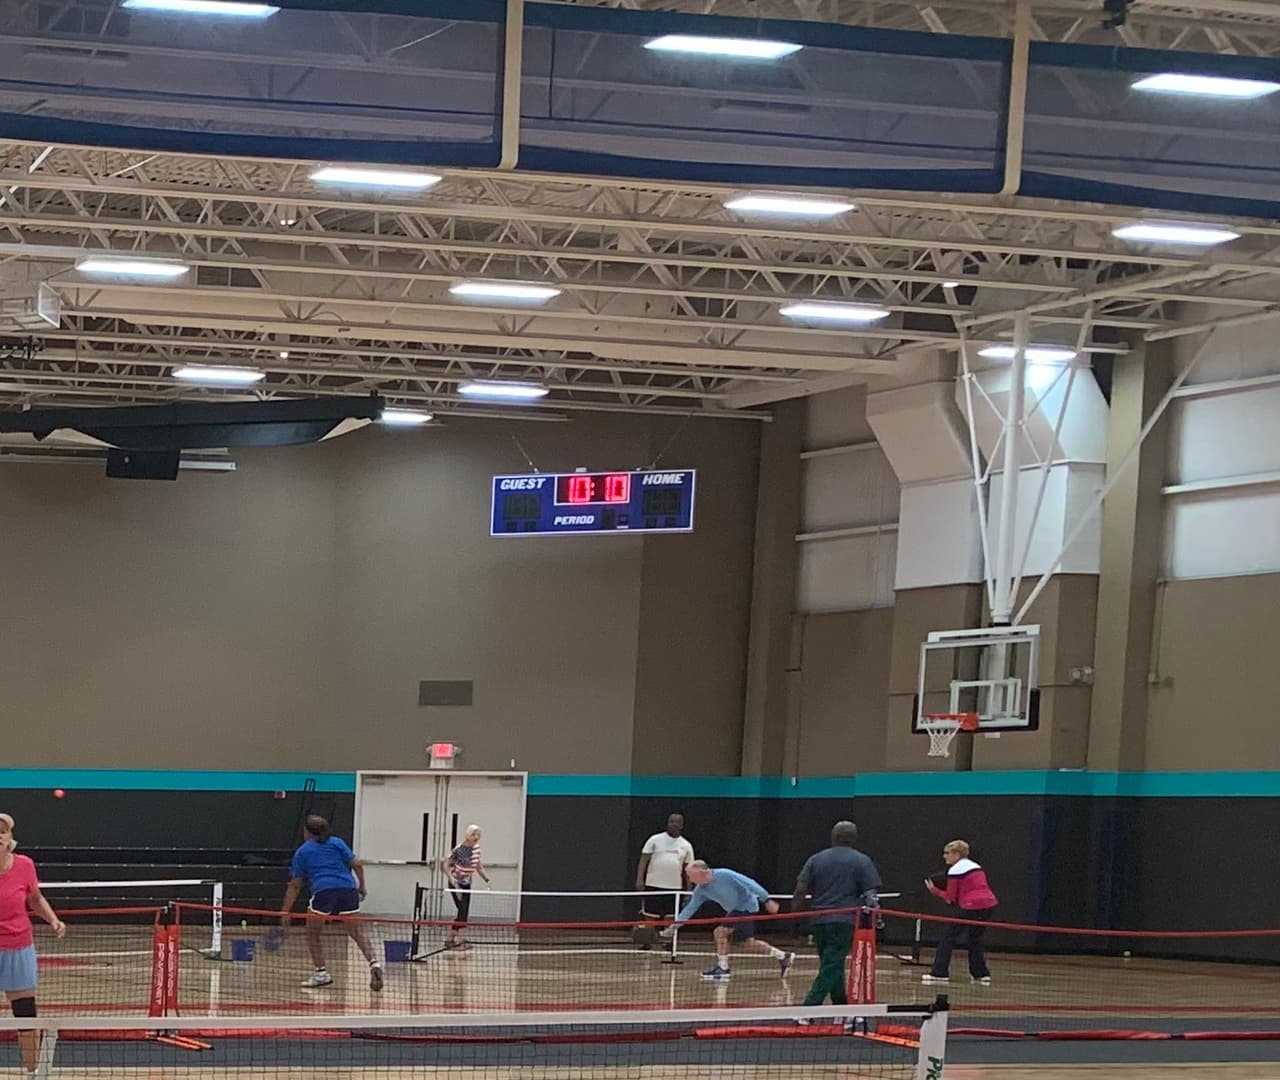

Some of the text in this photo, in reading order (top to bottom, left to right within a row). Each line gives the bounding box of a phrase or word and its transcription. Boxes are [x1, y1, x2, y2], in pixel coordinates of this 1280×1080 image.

[500, 477, 546, 490] GUEST
[642, 473, 685, 486] HOME
[553, 515, 595, 526] PERIOD
